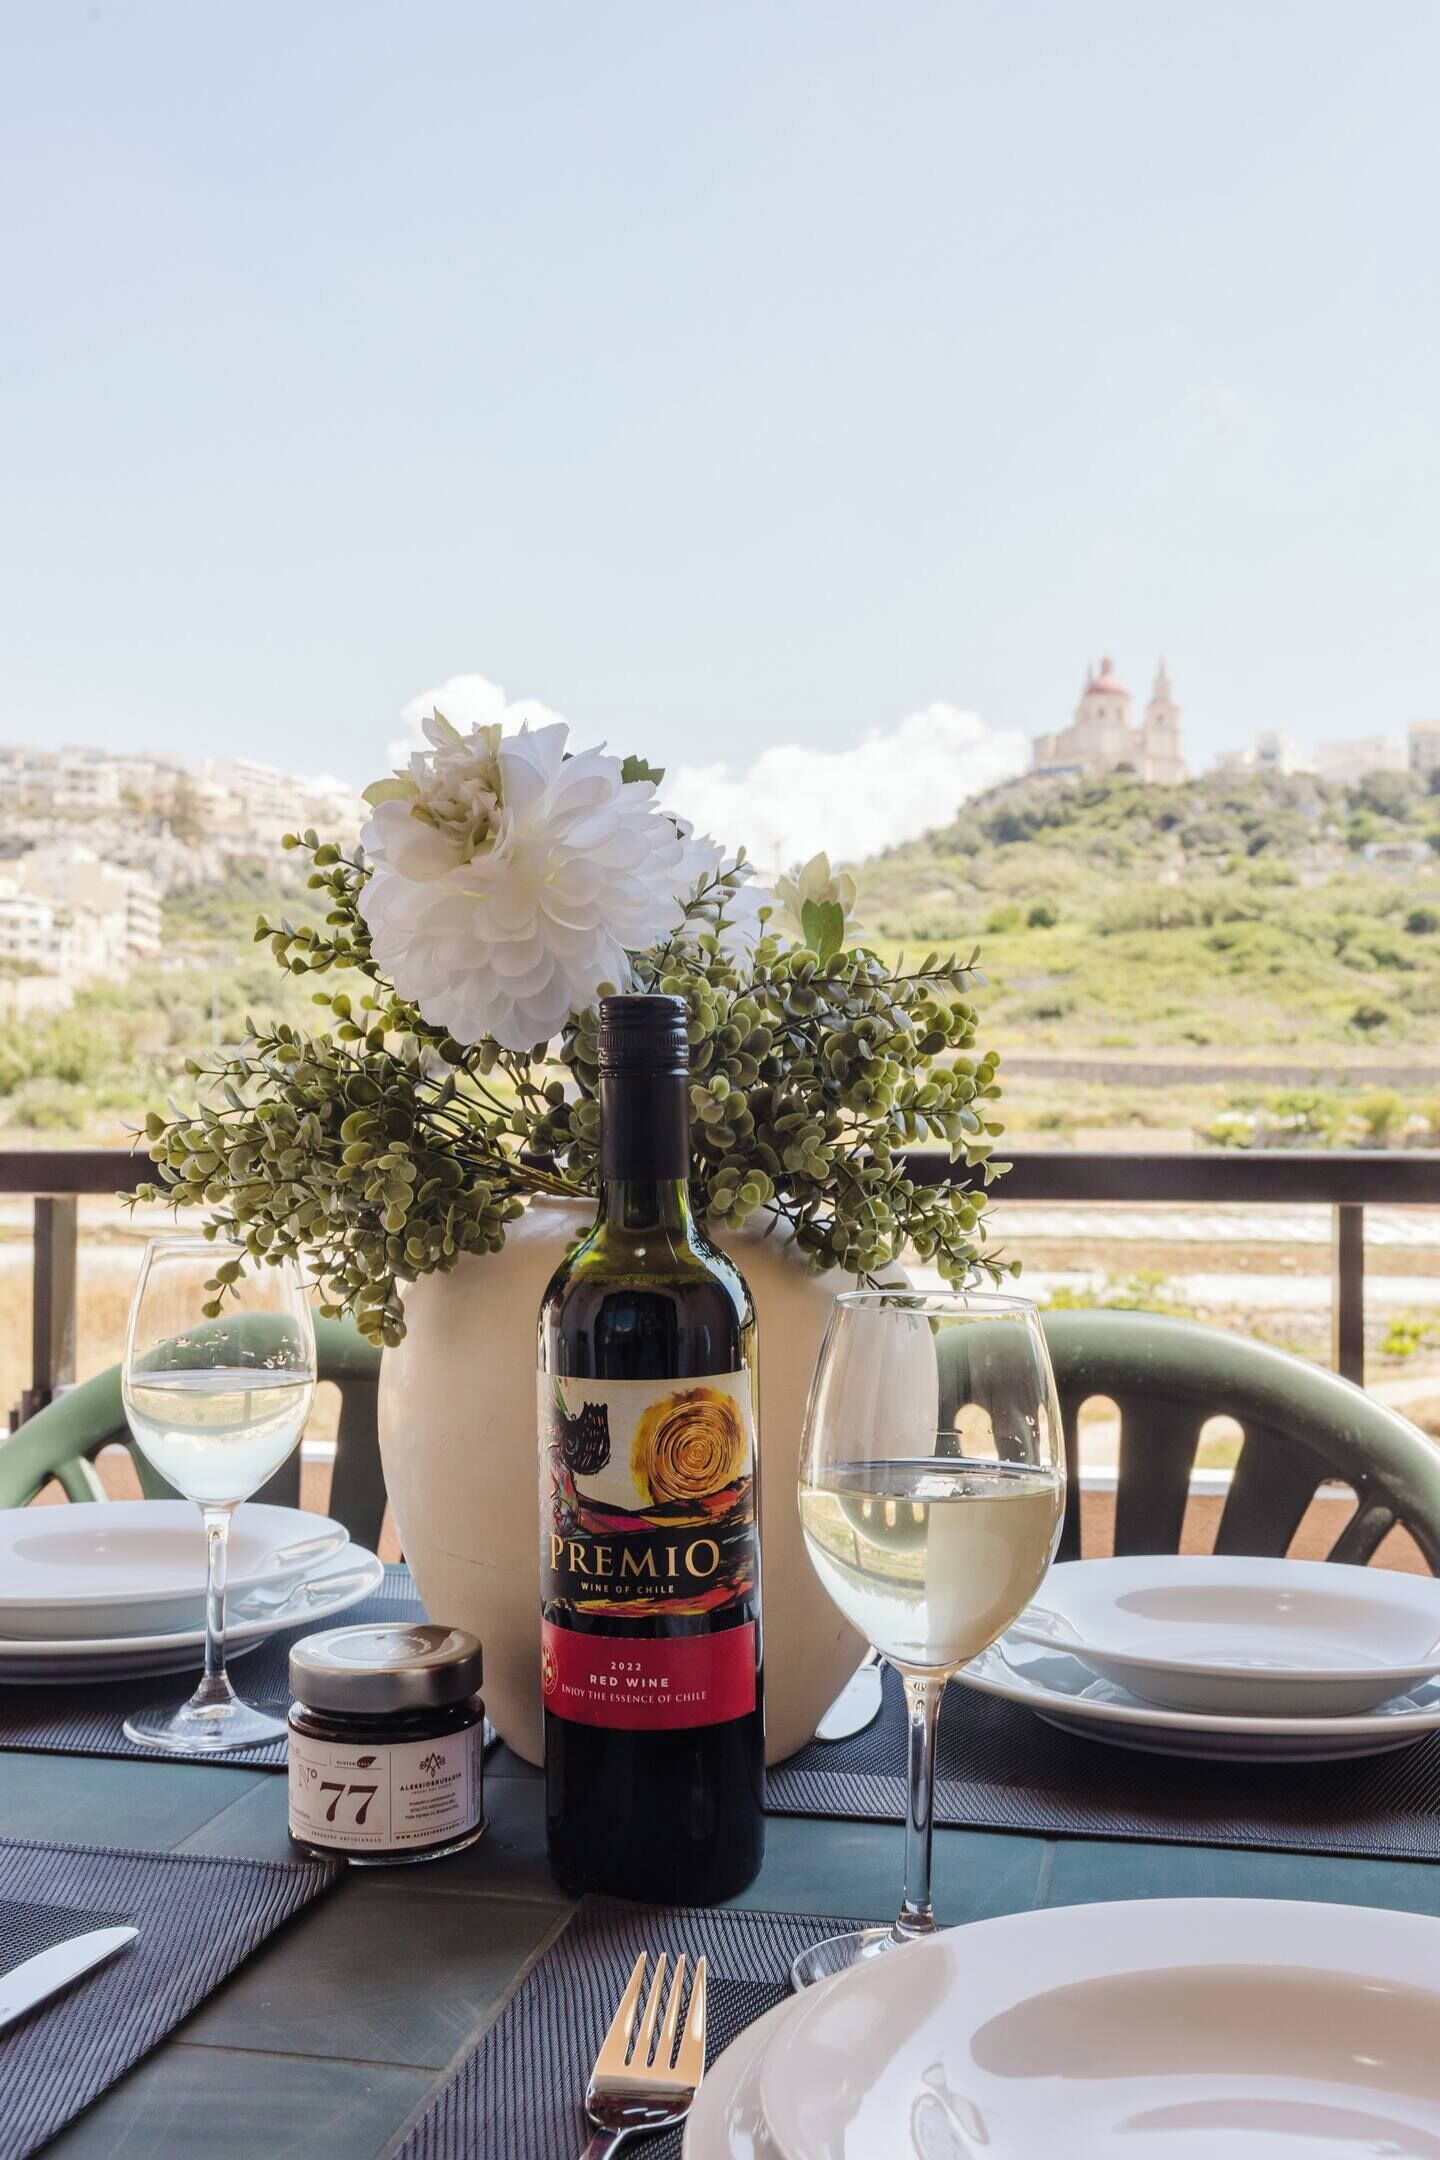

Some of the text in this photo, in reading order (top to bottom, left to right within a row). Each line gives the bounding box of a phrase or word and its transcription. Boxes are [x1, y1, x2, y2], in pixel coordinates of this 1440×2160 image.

[550, 1533, 720, 1578] PREMIO
[581, 1581, 675, 1594] WINE OF CHILE
[610, 1661, 642, 1671] 2022
[589, 1674, 669, 1688] RED WINE
[561, 1683, 707, 1703] ENJOY THE ESSENCE OF CHILE
[320, 1781, 378, 1825] 77
